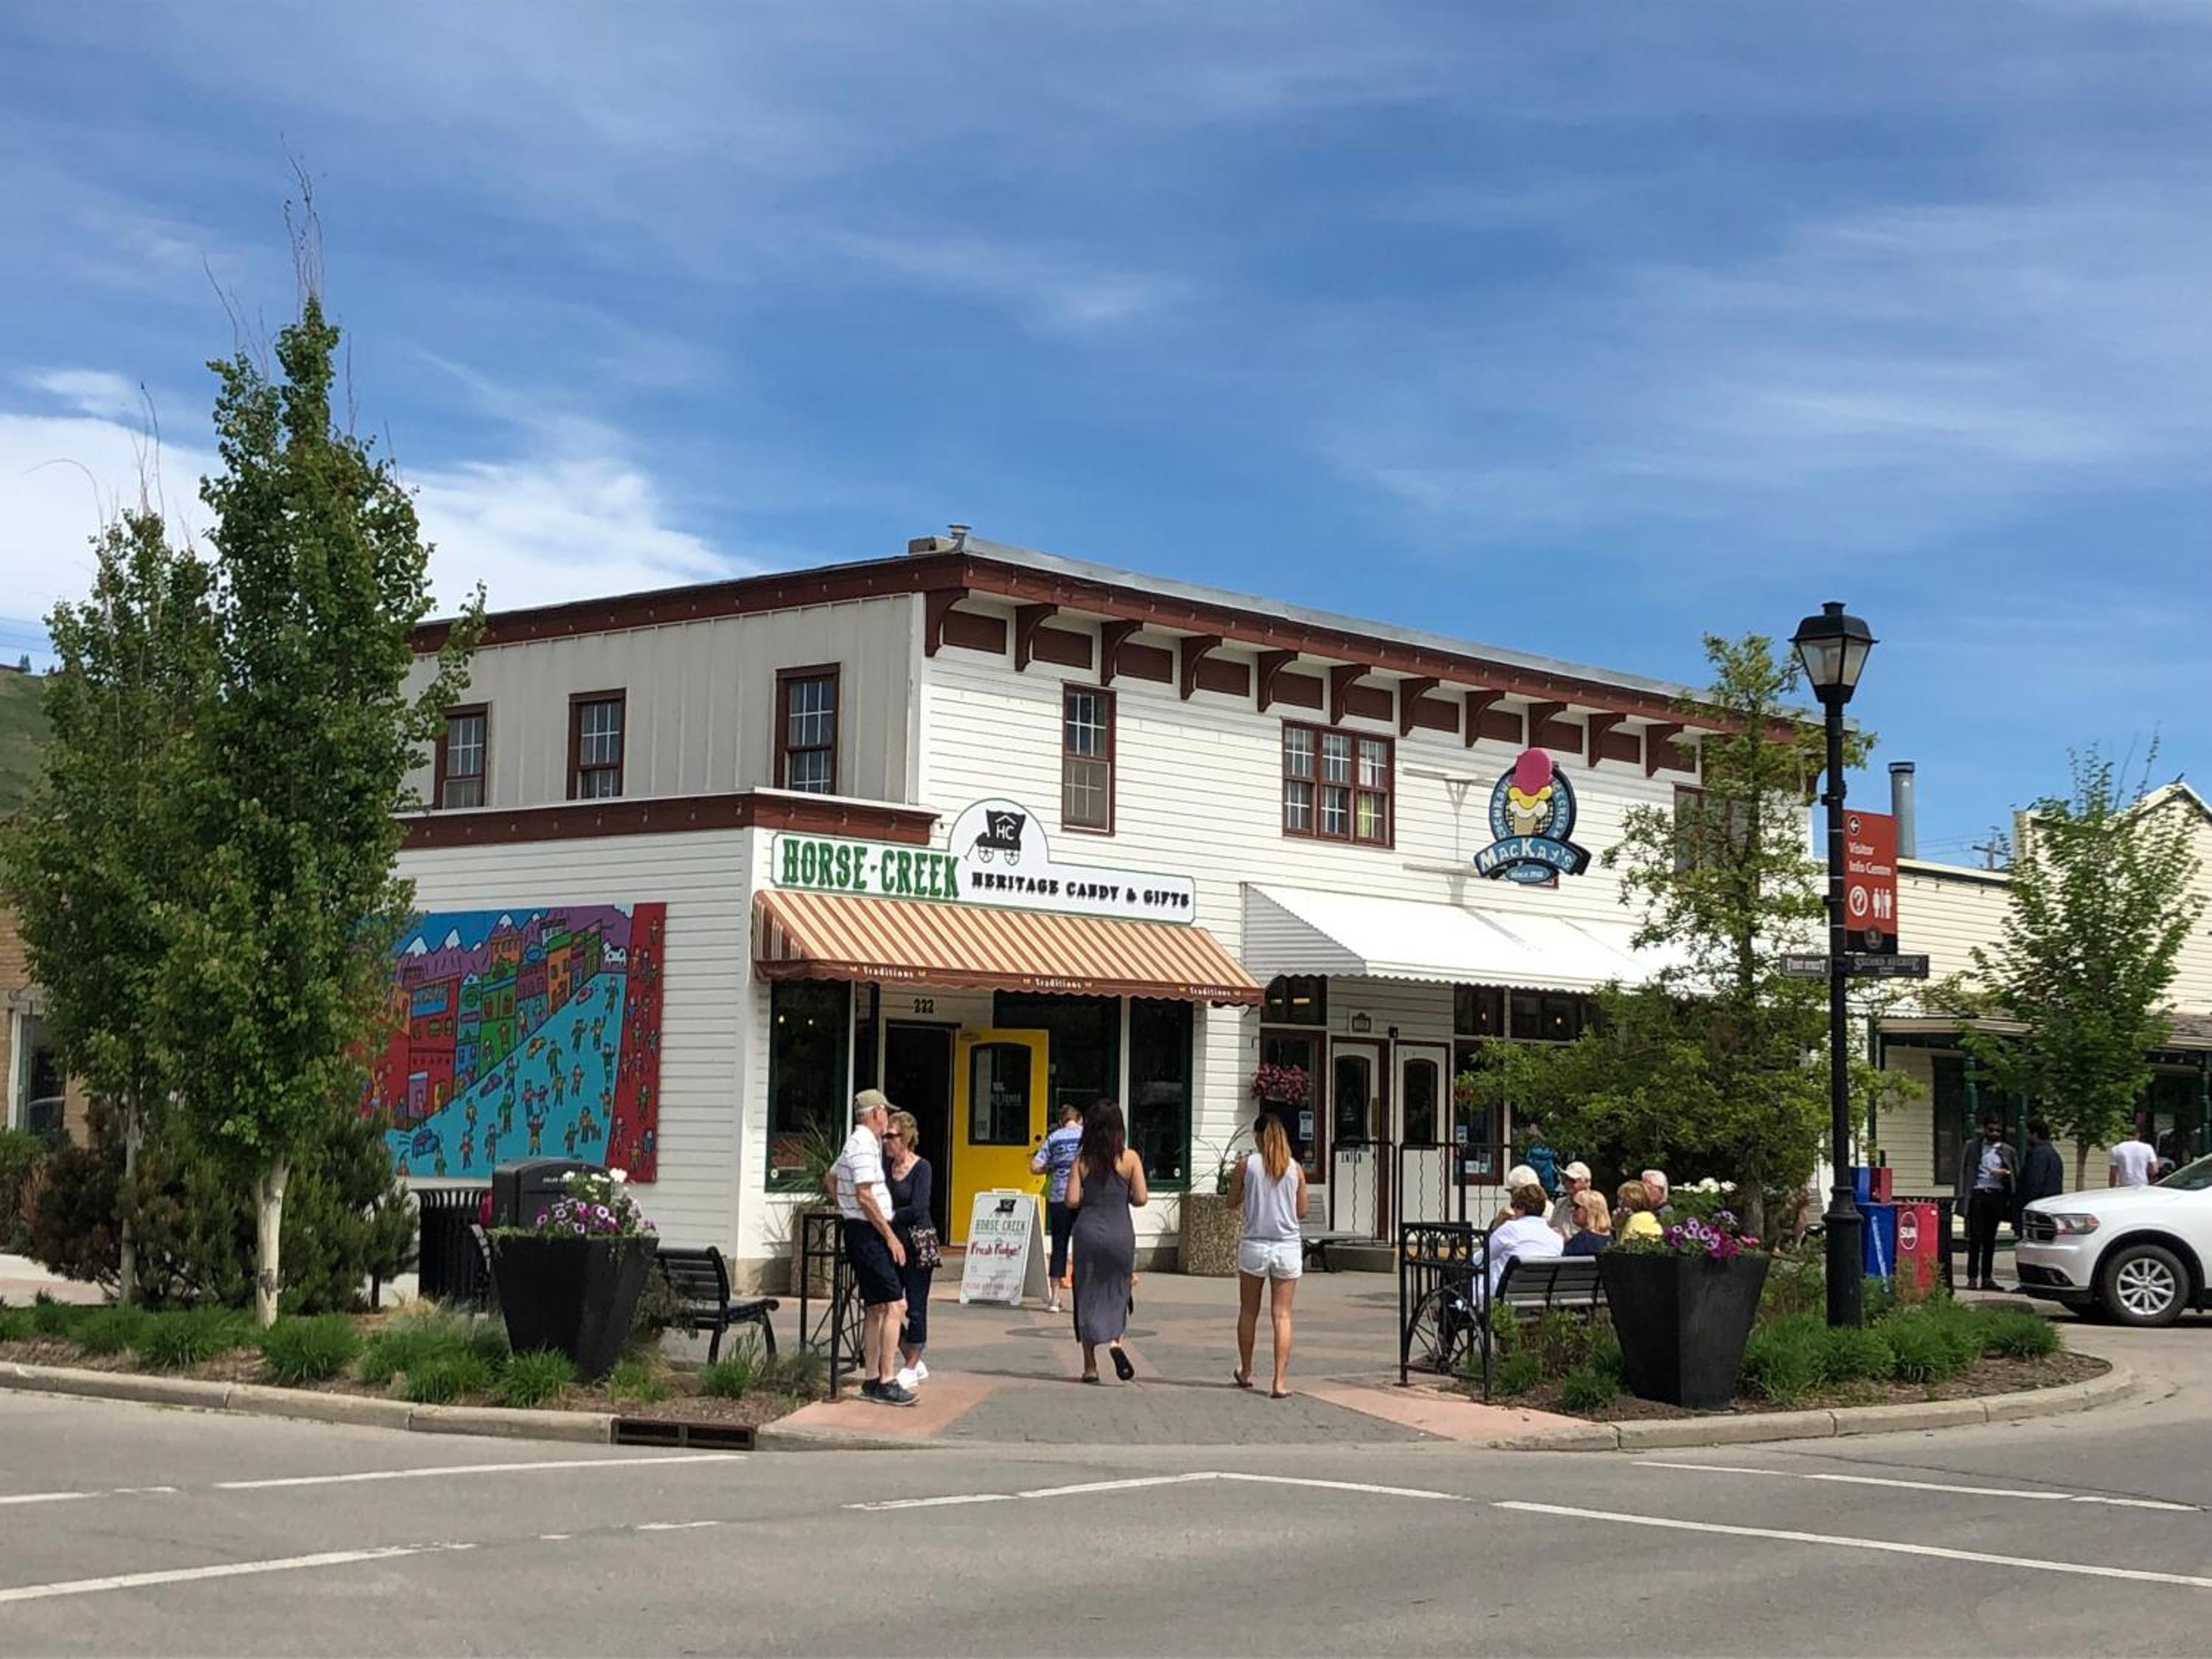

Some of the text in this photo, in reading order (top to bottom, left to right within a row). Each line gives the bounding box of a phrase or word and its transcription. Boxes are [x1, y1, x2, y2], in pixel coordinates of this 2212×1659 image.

[995, 823, 1015, 840] HC
[782, 838, 959, 898] HORSE CREEK
[972, 872, 1189, 908] HERITAGE CANDY & GIFTS
[863, 965, 914, 978] Traditions
[1035, 978, 1082, 990] Traditions
[1189, 987, 1231, 997] Traditions
[914, 998, 934, 1013] 222
